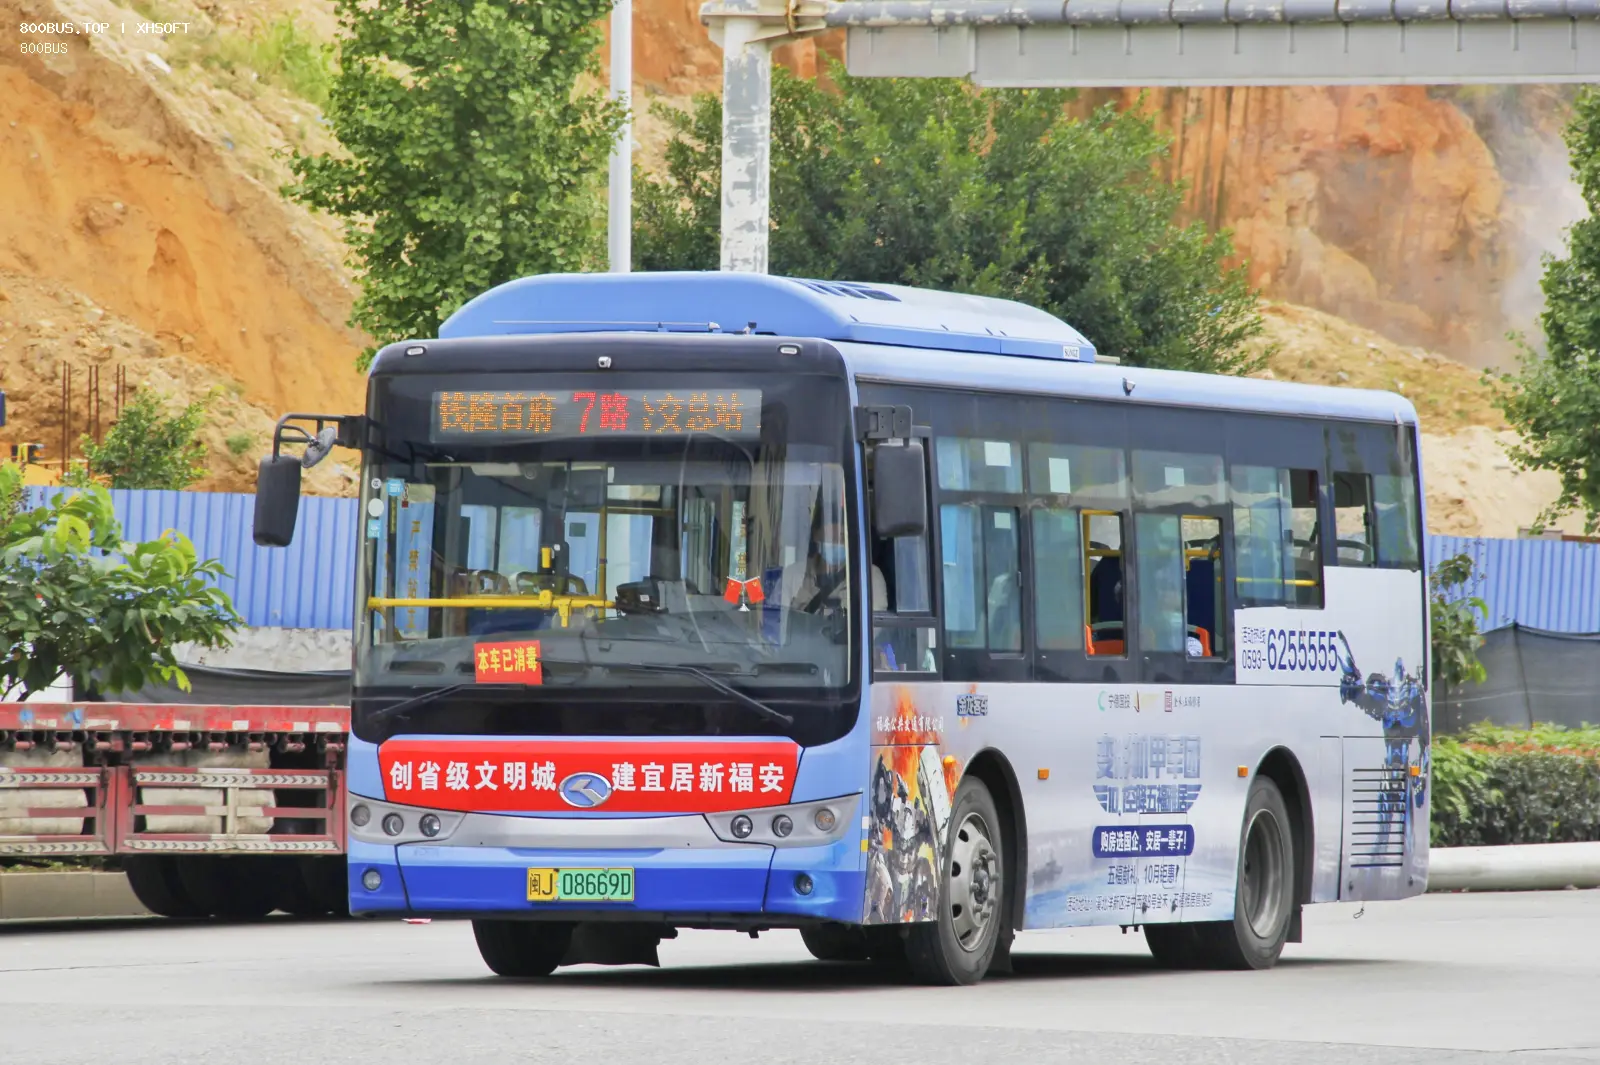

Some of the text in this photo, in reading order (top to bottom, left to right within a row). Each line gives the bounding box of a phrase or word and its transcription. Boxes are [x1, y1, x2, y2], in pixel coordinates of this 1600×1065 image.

[572, 392, 630, 433] 7路
[477, 648, 540, 673] 本车已消毒
[389, 760, 785, 794] 创省级文明城 建宜居新福安
[562, 872, 632, 896] 08669D
